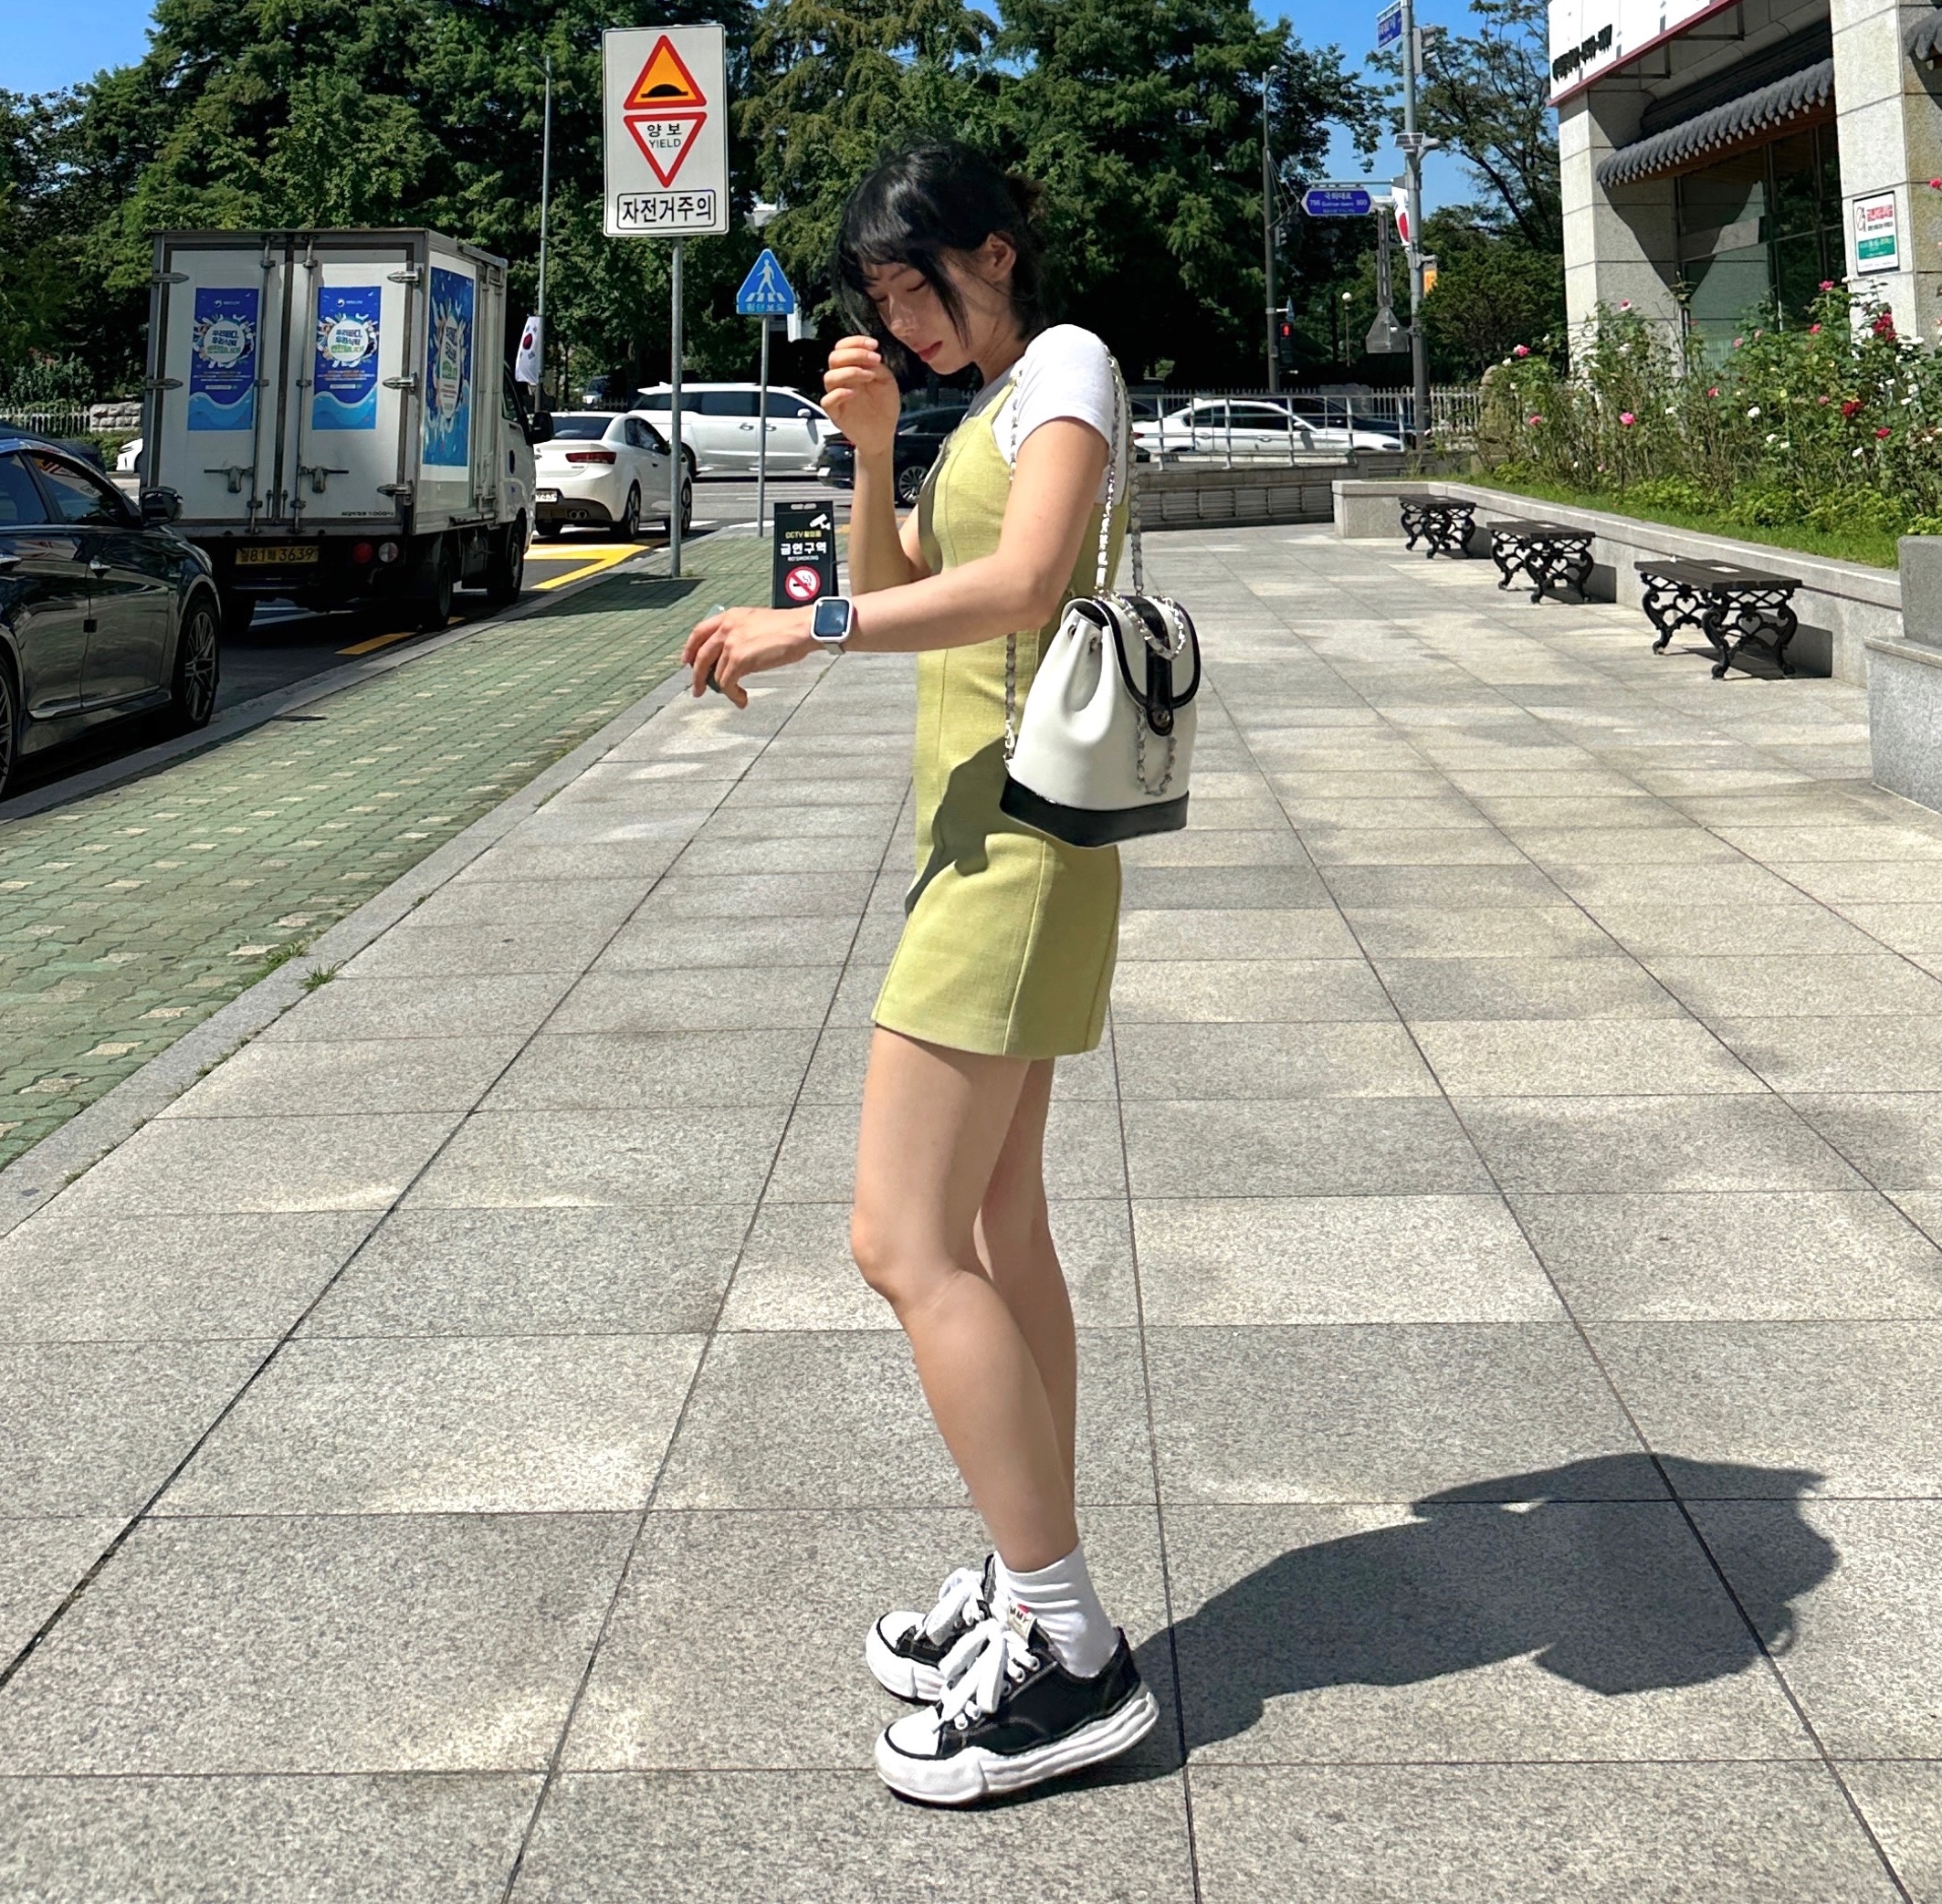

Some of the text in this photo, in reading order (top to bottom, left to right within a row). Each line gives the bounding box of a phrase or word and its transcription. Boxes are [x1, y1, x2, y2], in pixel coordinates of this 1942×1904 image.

[648, 138, 681, 149] YIELD
[622, 195, 711, 224] 자전거주의
[785, 531, 803, 539] CCTV
[278, 547, 314, 562] 3639
[781, 541, 827, 555] 금연구역
